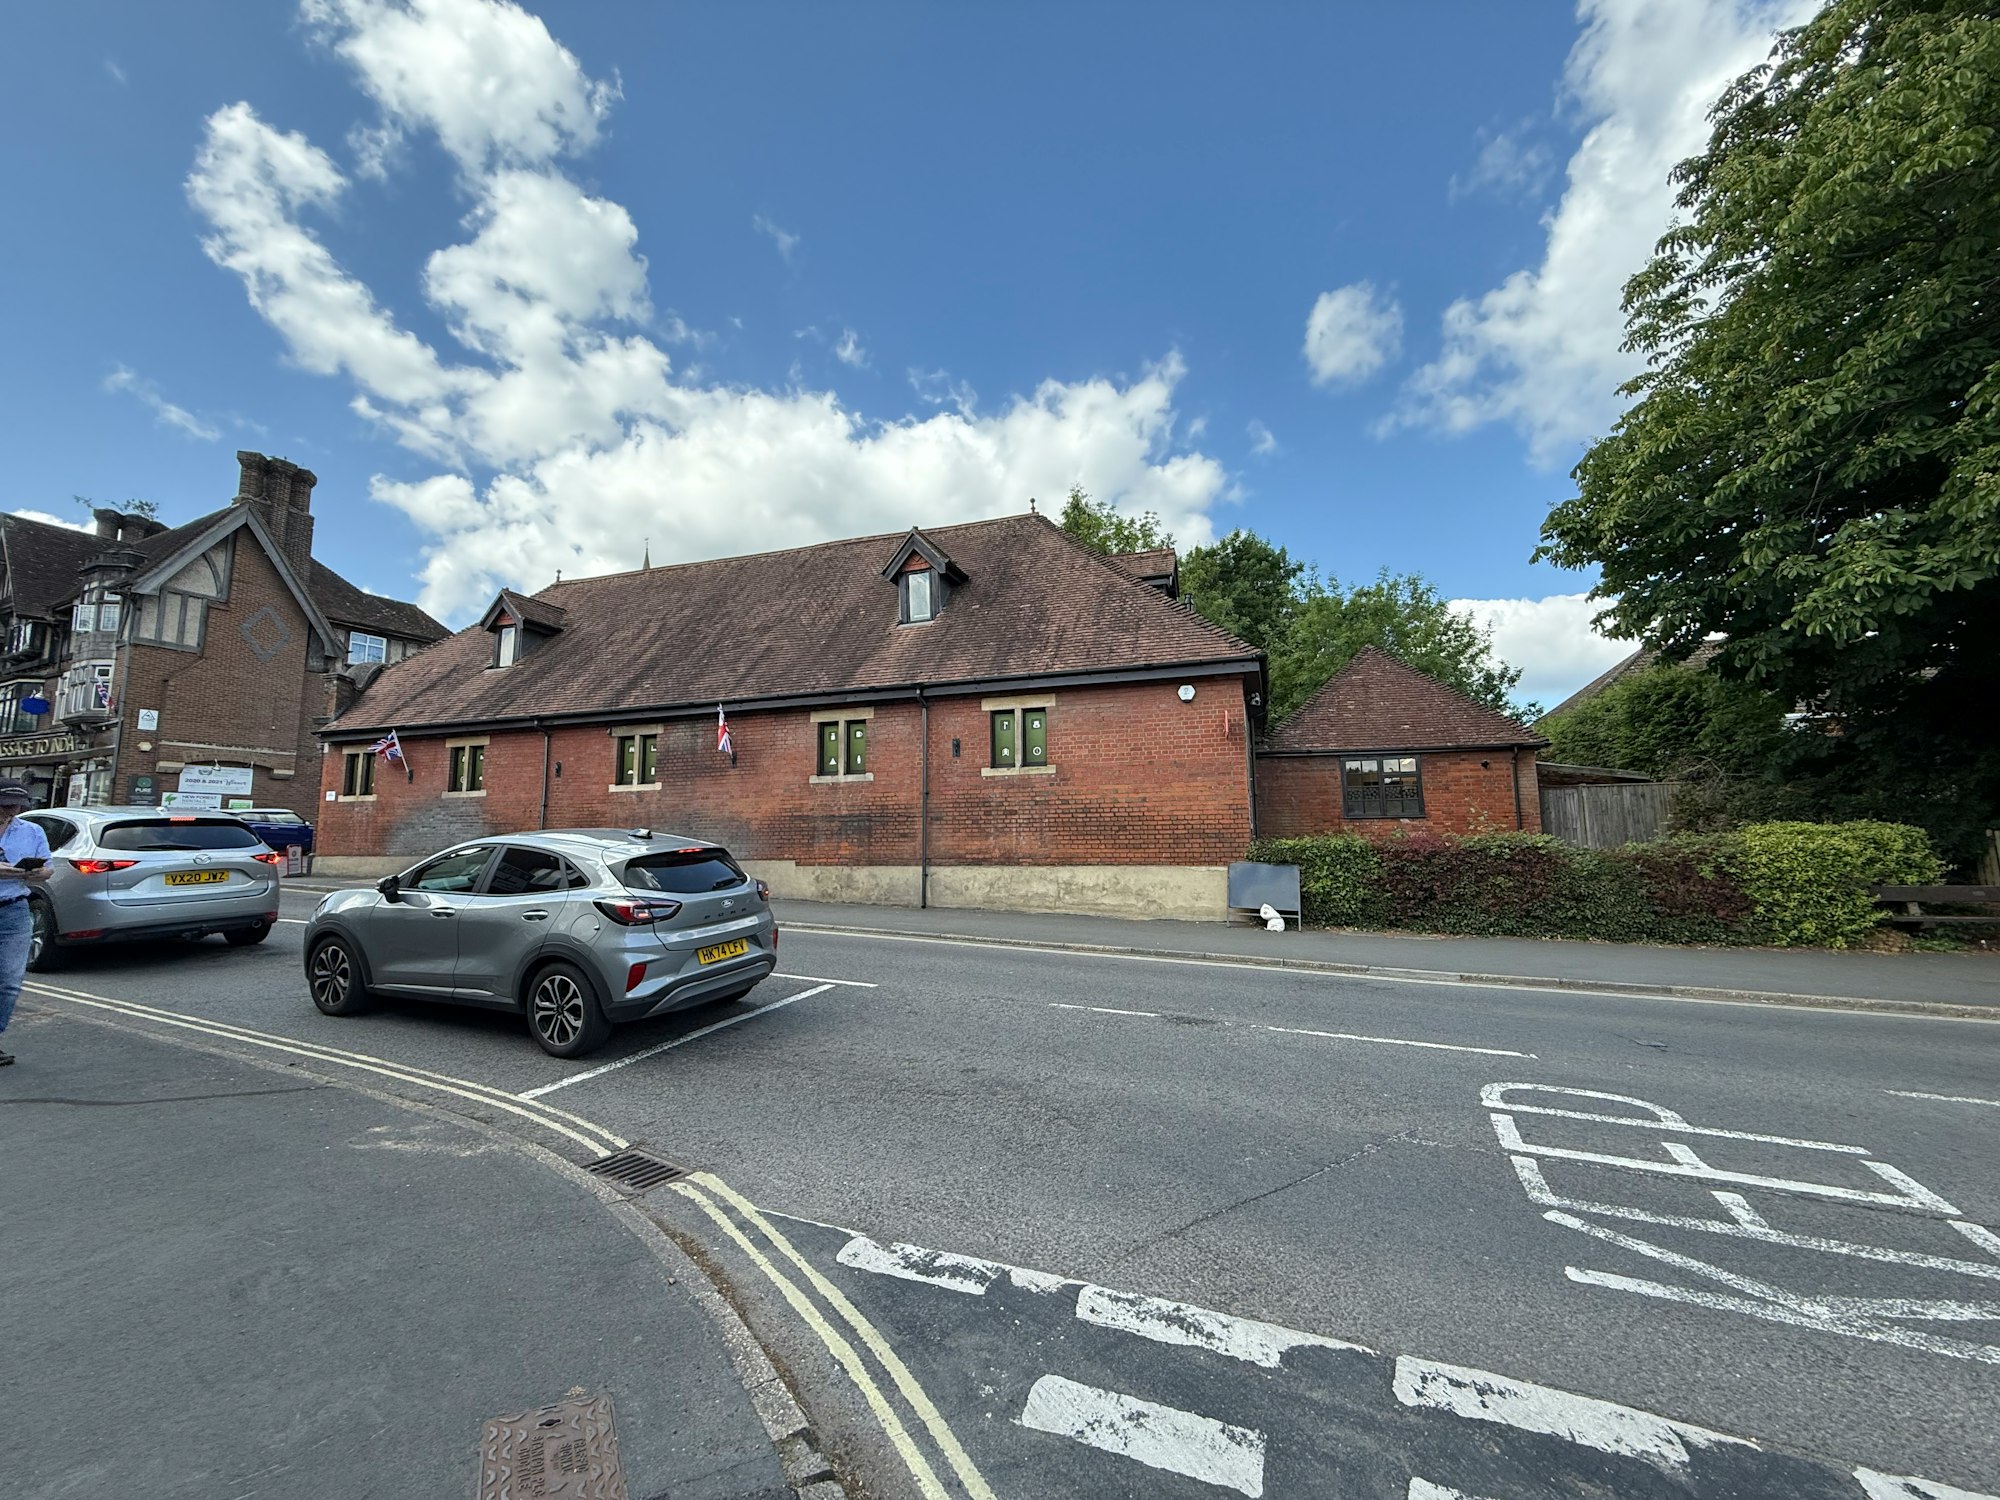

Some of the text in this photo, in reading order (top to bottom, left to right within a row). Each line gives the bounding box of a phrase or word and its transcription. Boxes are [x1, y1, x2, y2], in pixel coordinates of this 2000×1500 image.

[34, 739, 49, 755] TO
[170, 871, 225, 883] VX20 JWZ
[701, 939, 745, 961] HK74 LFV
